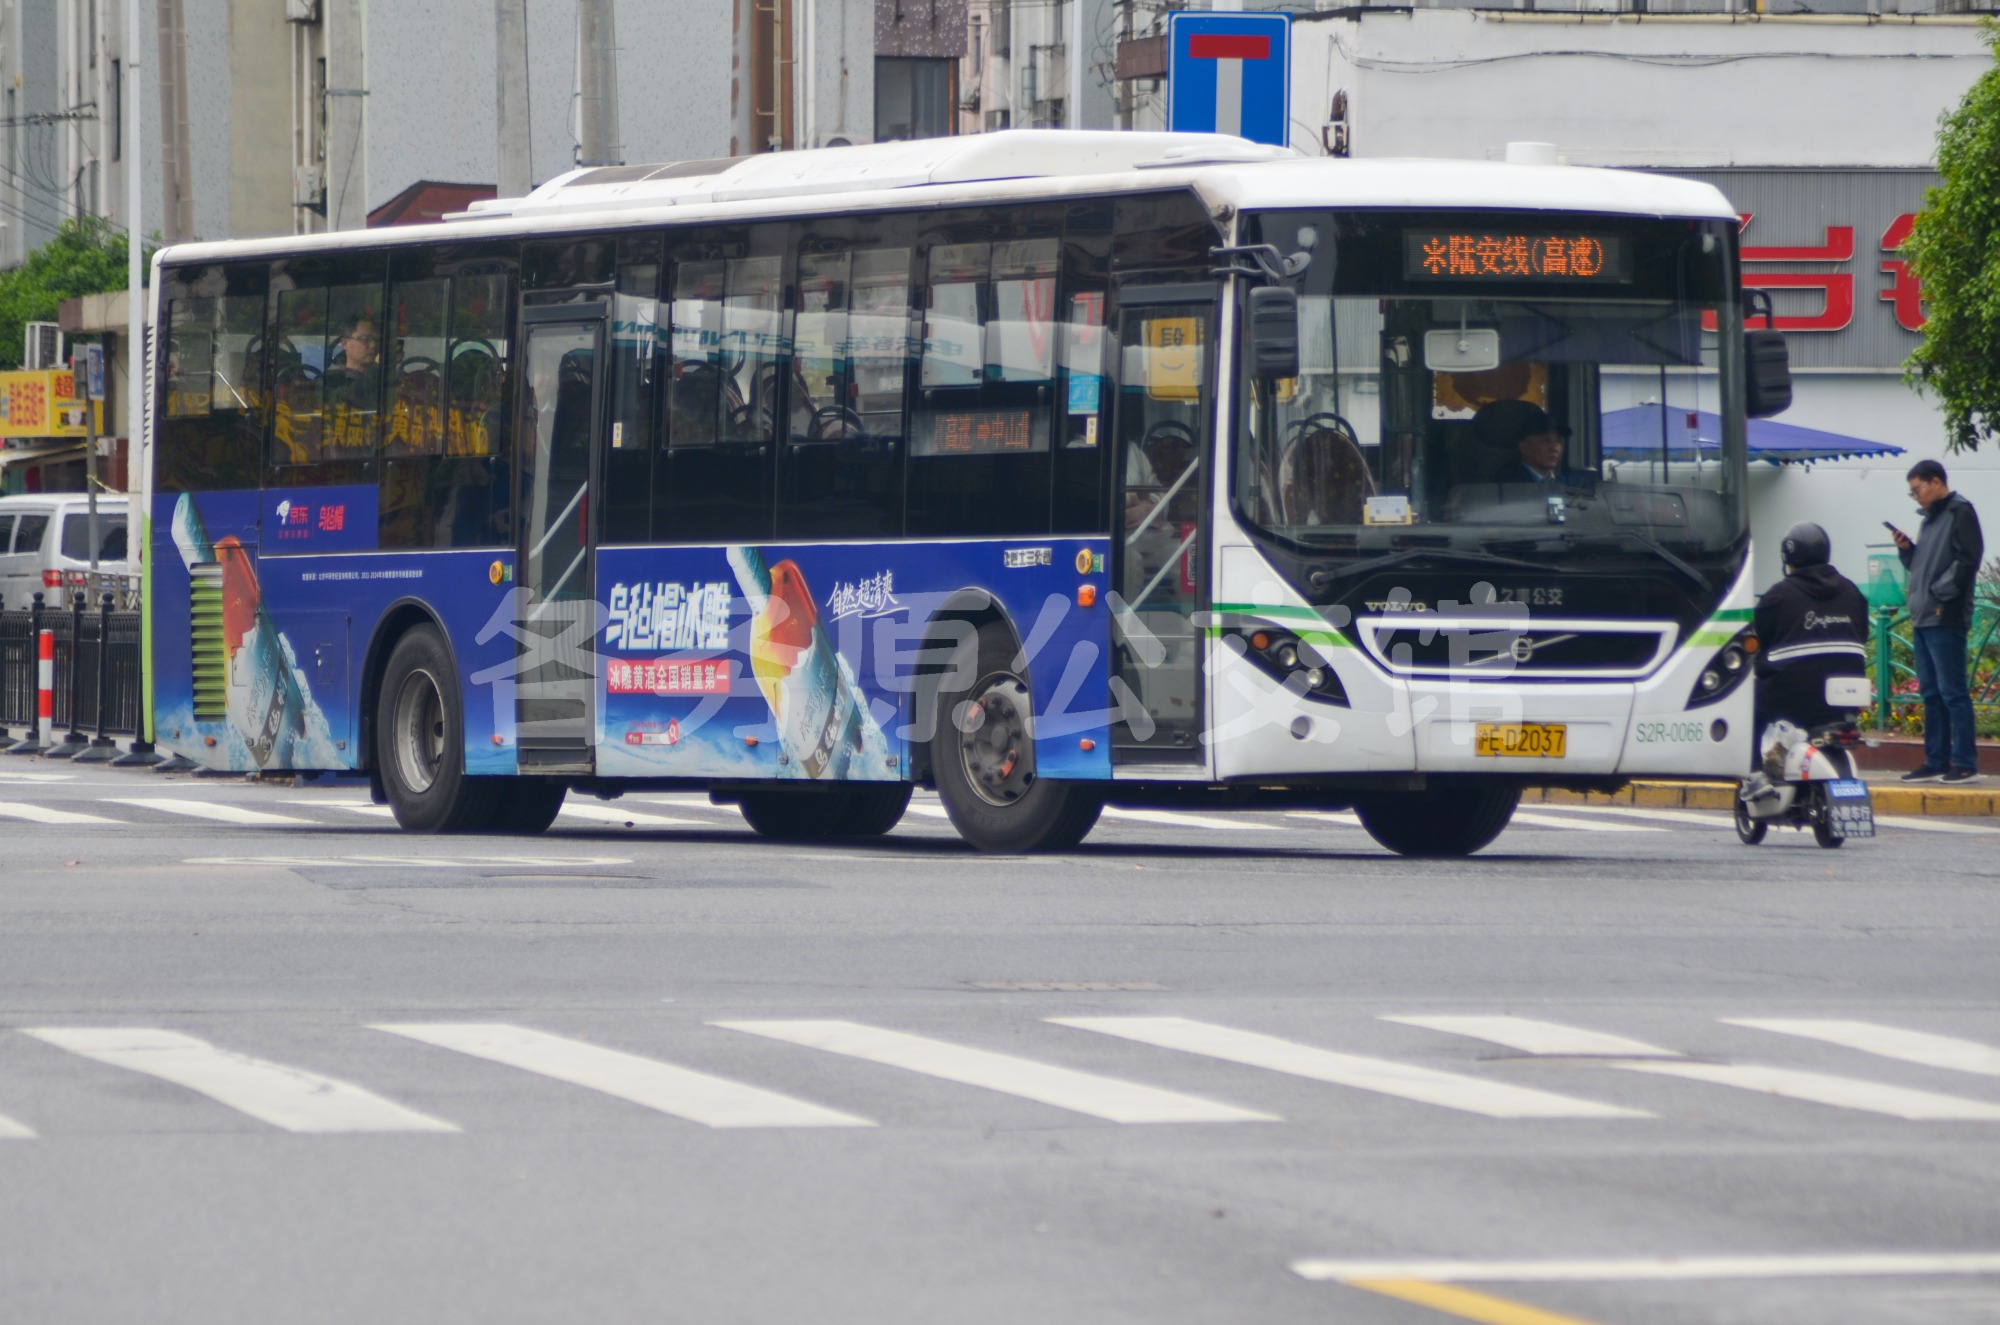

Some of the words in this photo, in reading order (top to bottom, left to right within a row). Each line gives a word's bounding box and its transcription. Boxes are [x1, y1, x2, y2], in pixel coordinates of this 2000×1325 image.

[290, 506, 308, 525] 京东
[606, 582, 731, 650] 乌毡帽冰雕
[1365, 601, 1427, 612] VOLVO
[609, 665, 728, 690] 冰雕黄酒全国销量第一
[1636, 723, 1703, 743] S2R-0066
